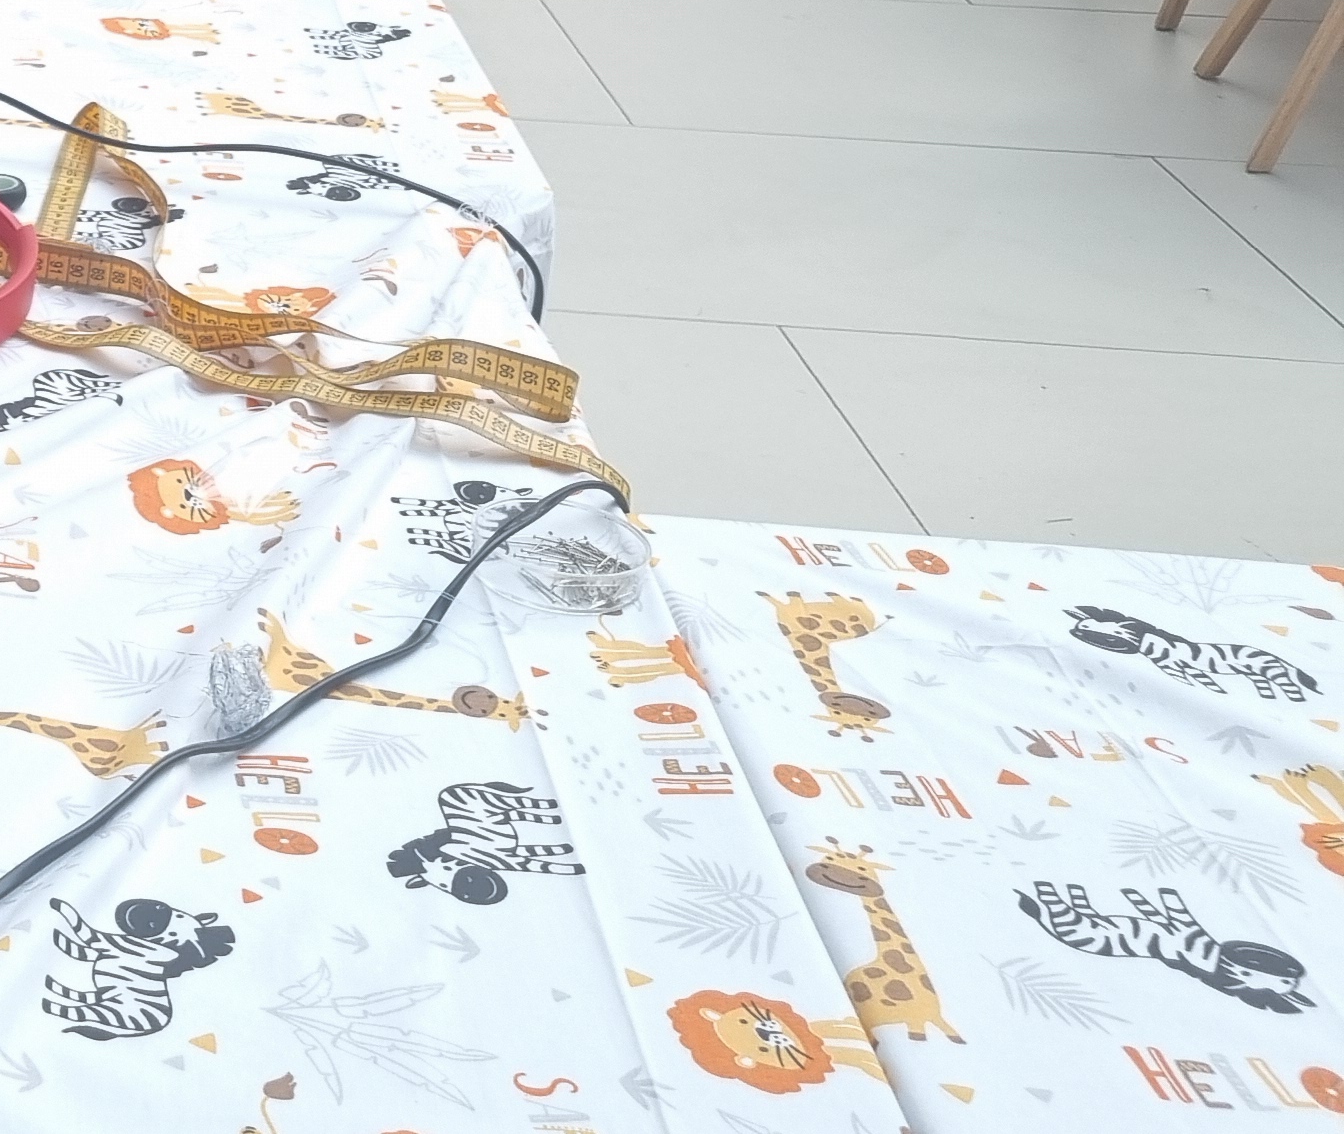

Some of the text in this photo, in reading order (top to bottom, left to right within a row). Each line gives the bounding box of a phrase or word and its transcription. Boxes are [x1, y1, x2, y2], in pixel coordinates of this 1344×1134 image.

[775, 535, 951, 575] HELLO
[633, 702, 735, 796] HELLO
[994, 725, 1190, 764] SAFARI
[235, 754, 323, 858] HELLO
[772, 763, 974, 820] HELLO
[1123, 1045, 1344, 1117] HELLO
